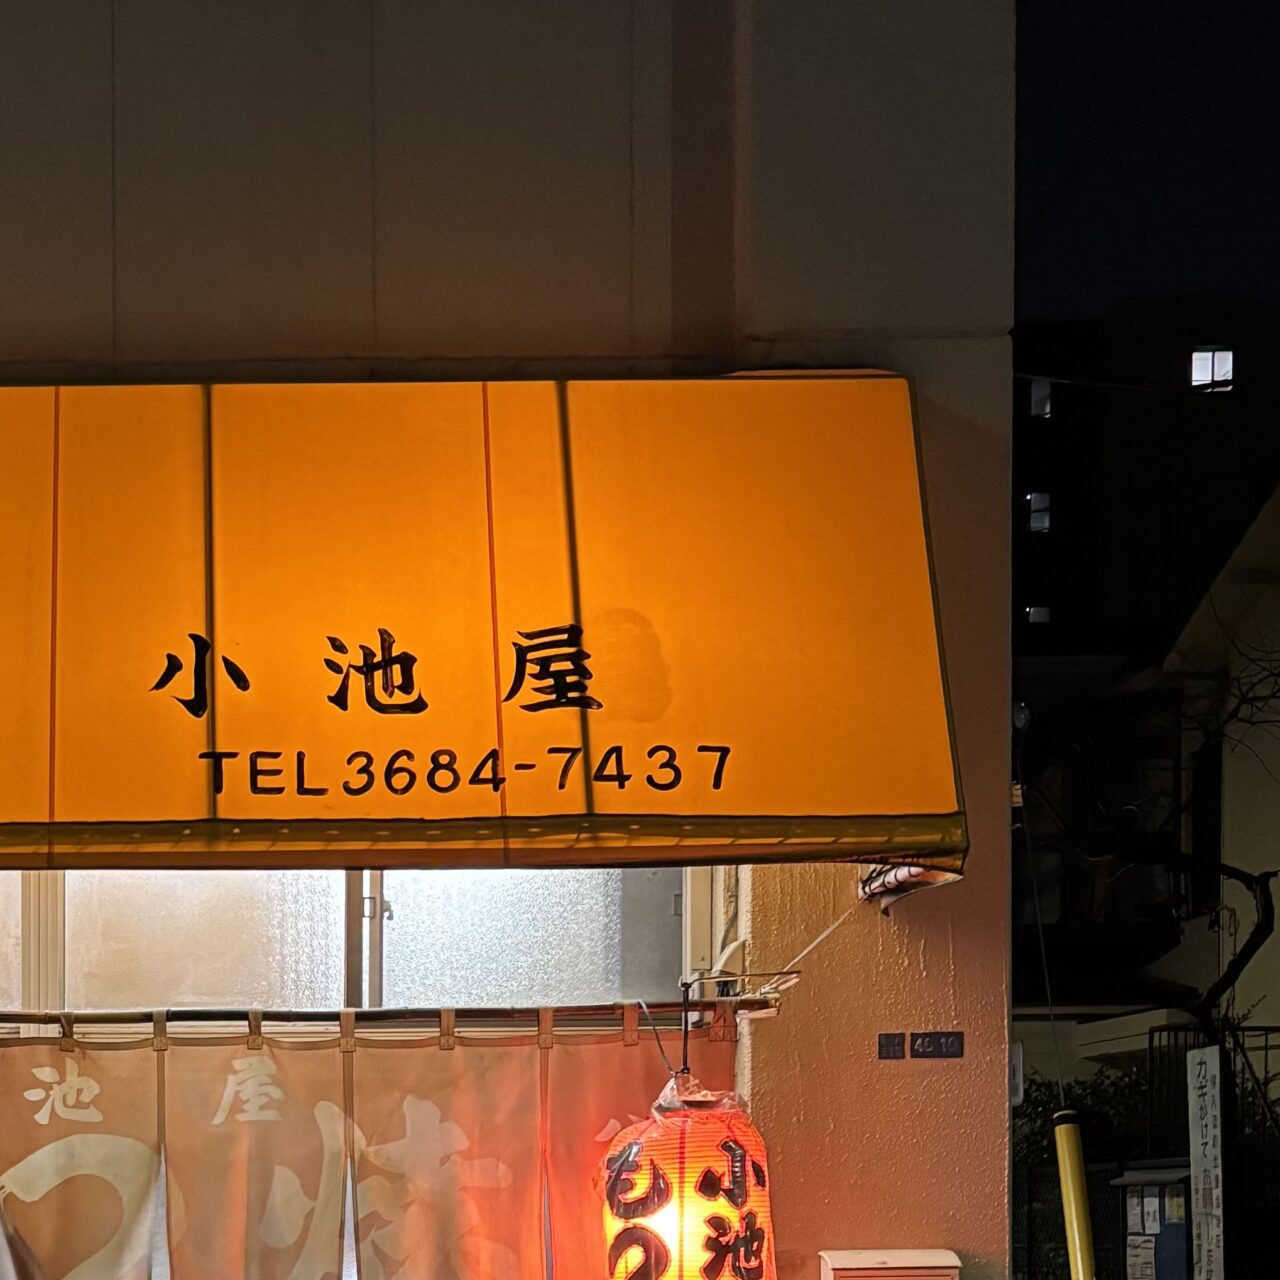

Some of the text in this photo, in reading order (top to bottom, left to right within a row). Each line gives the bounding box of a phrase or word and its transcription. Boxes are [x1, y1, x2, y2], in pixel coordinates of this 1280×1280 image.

[149, 622, 604, 719] 小池屋
[342, 745, 732, 797] 3684-7437
